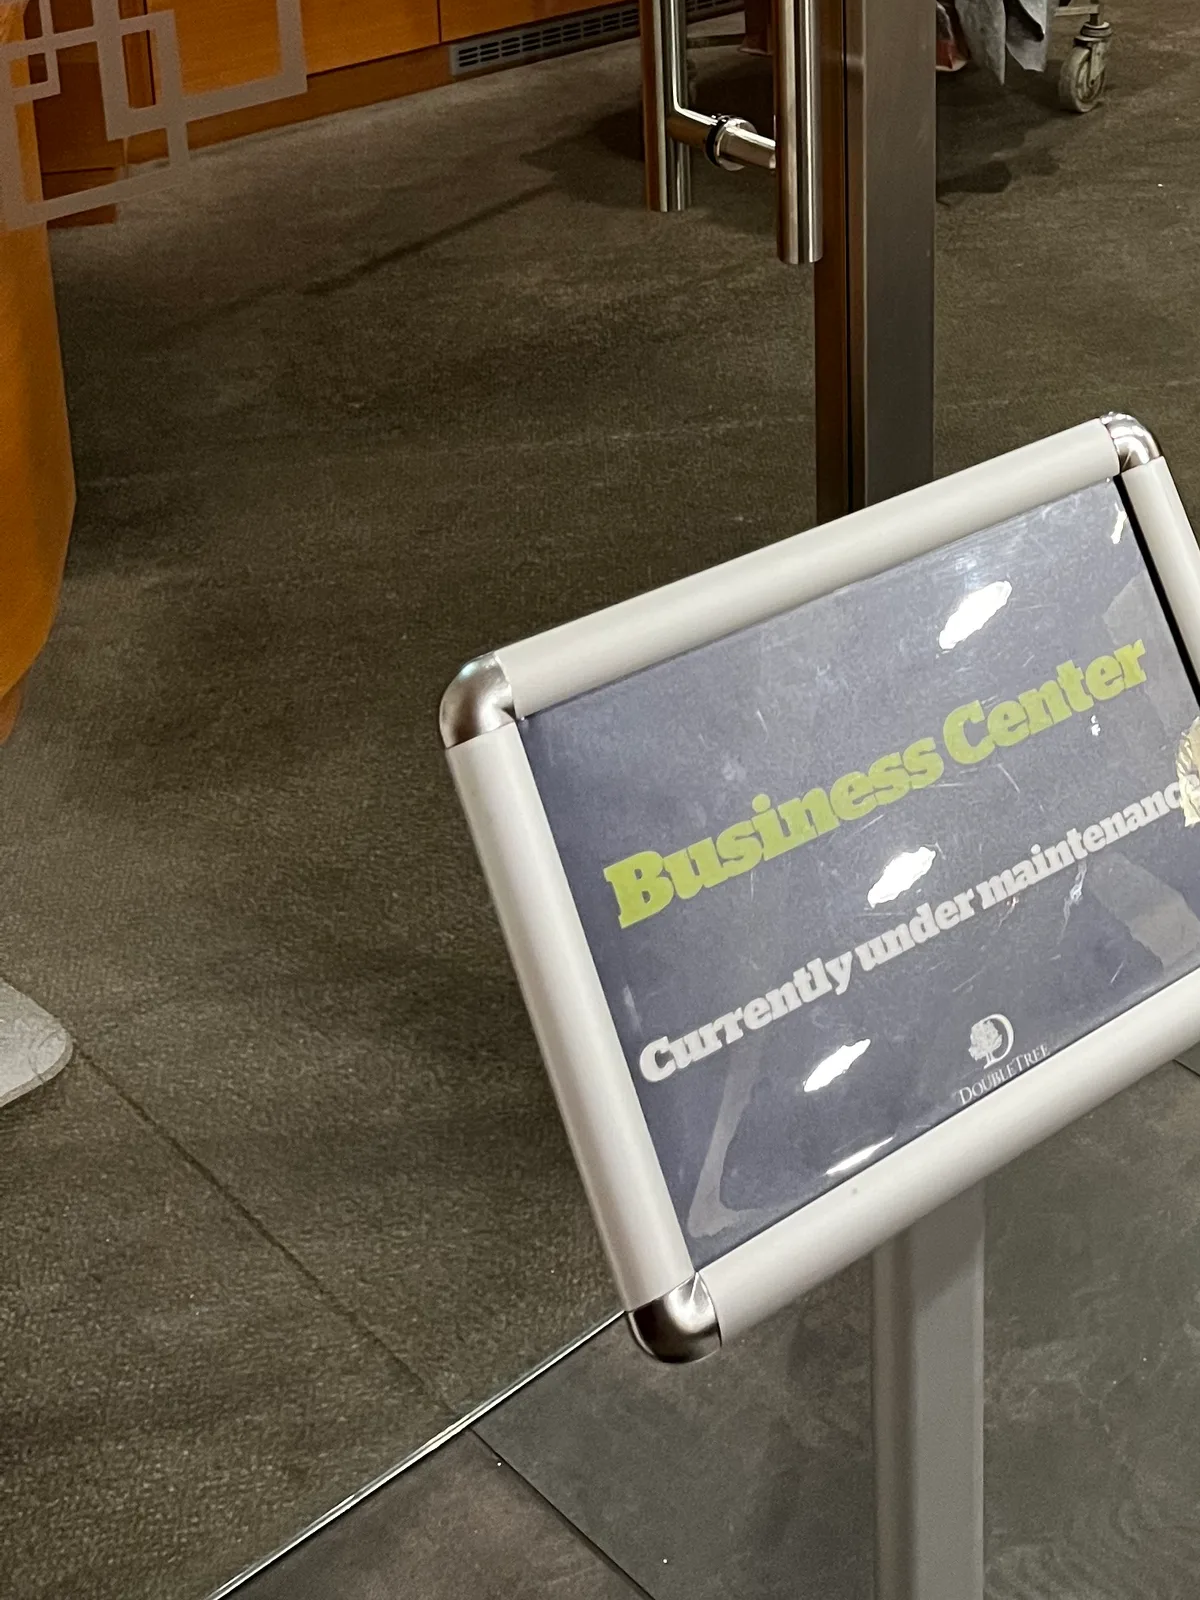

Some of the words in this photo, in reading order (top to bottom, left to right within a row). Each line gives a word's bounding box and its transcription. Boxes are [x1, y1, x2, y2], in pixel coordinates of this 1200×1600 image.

[604, 738, 944, 929] Business
[943, 639, 1147, 765] Center
[640, 951, 852, 1082] Currently
[855, 888, 976, 972] under
